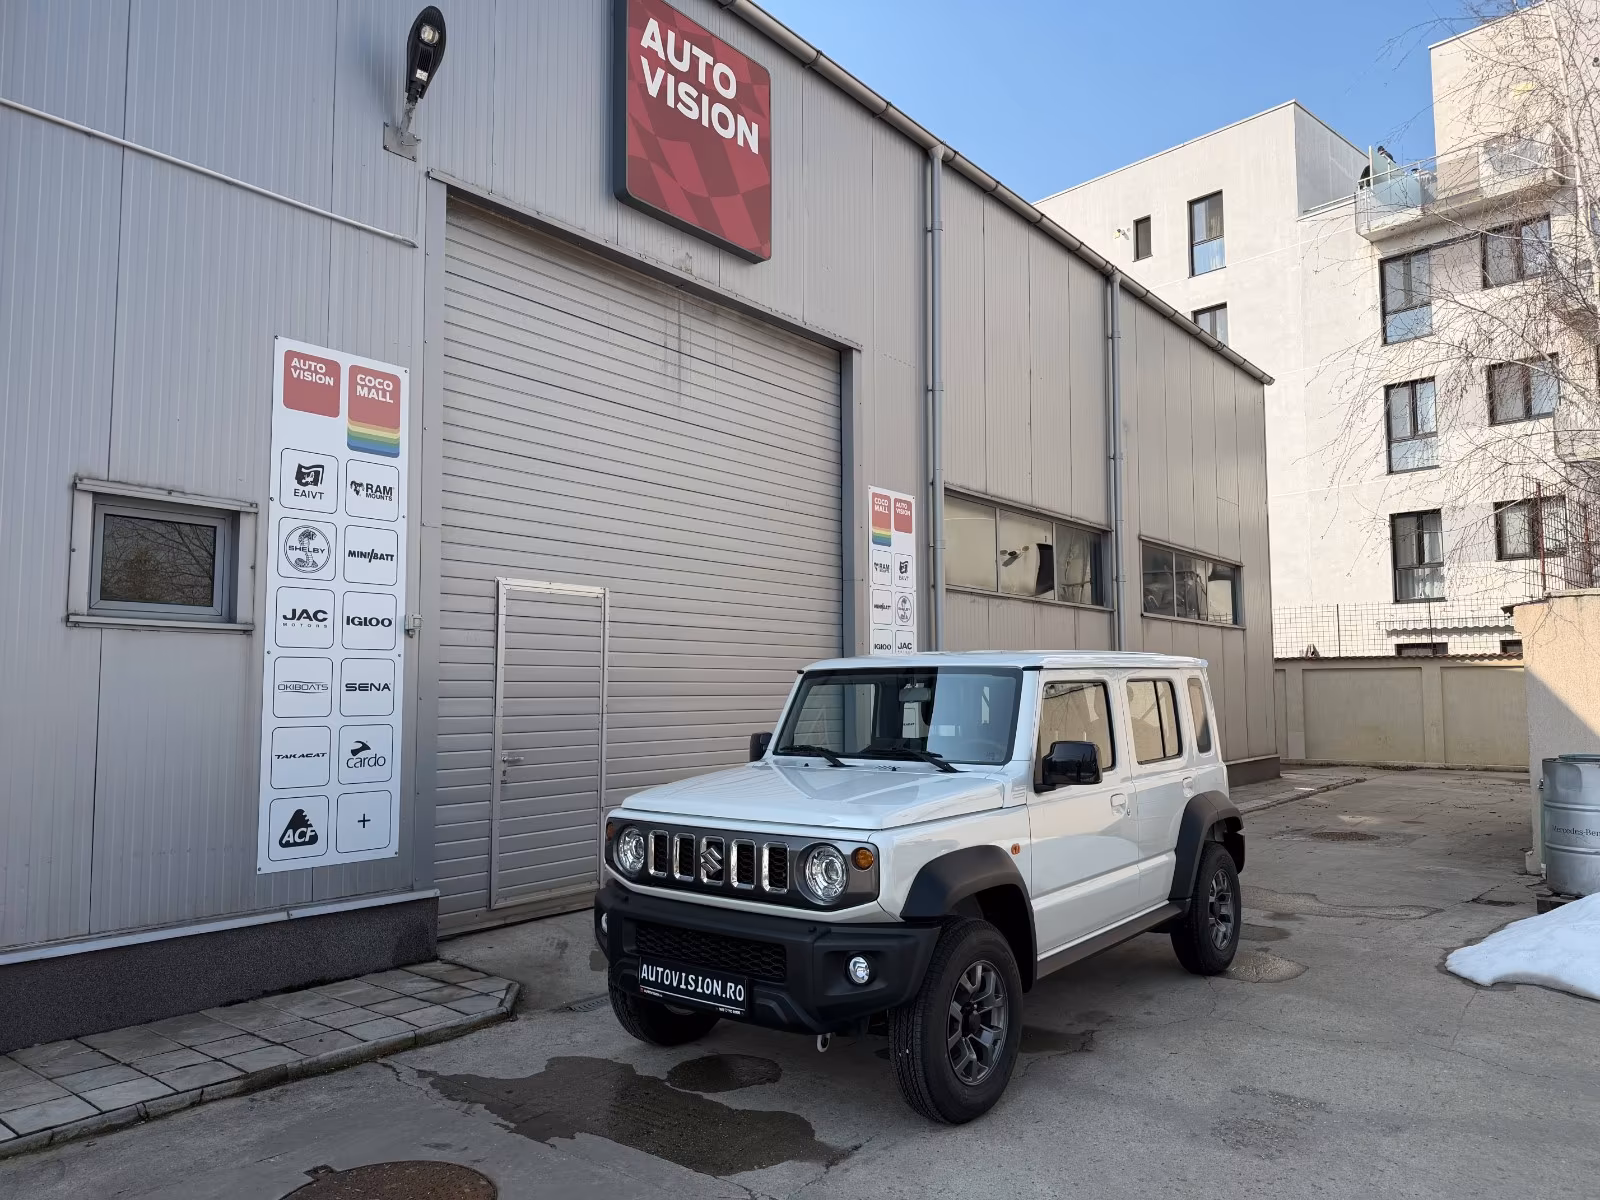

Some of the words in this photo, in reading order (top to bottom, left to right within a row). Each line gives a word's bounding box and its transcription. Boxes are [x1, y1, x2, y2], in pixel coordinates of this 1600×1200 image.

[640, 17, 737, 100] AUTO
[640, 55, 759, 155] VISION
[291, 357, 326, 373] AUTO
[291, 368, 334, 386] VISION
[356, 373, 393, 391] COCO
[356, 385, 394, 404] MALL
[293, 488, 324, 500] EAIVT
[366, 483, 393, 496] RAM
[365, 492, 393, 502] MOUNTS
[874, 497, 889, 506] COCO
[874, 504, 889, 514] MALL
[896, 502, 908, 510] AUTO
[288, 545, 325, 554] SHELBY
[282, 608, 329, 622] JAC
[346, 615, 393, 628] IGLOO
[898, 642, 912, 650] JAC
[277, 683, 329, 692] OKIBOATS
[345, 682, 391, 692] SENA
[346, 753, 386, 769] cardo
[282, 827, 316, 844] ACF
[641, 963, 745, 1001] AUTOVISION.RO
